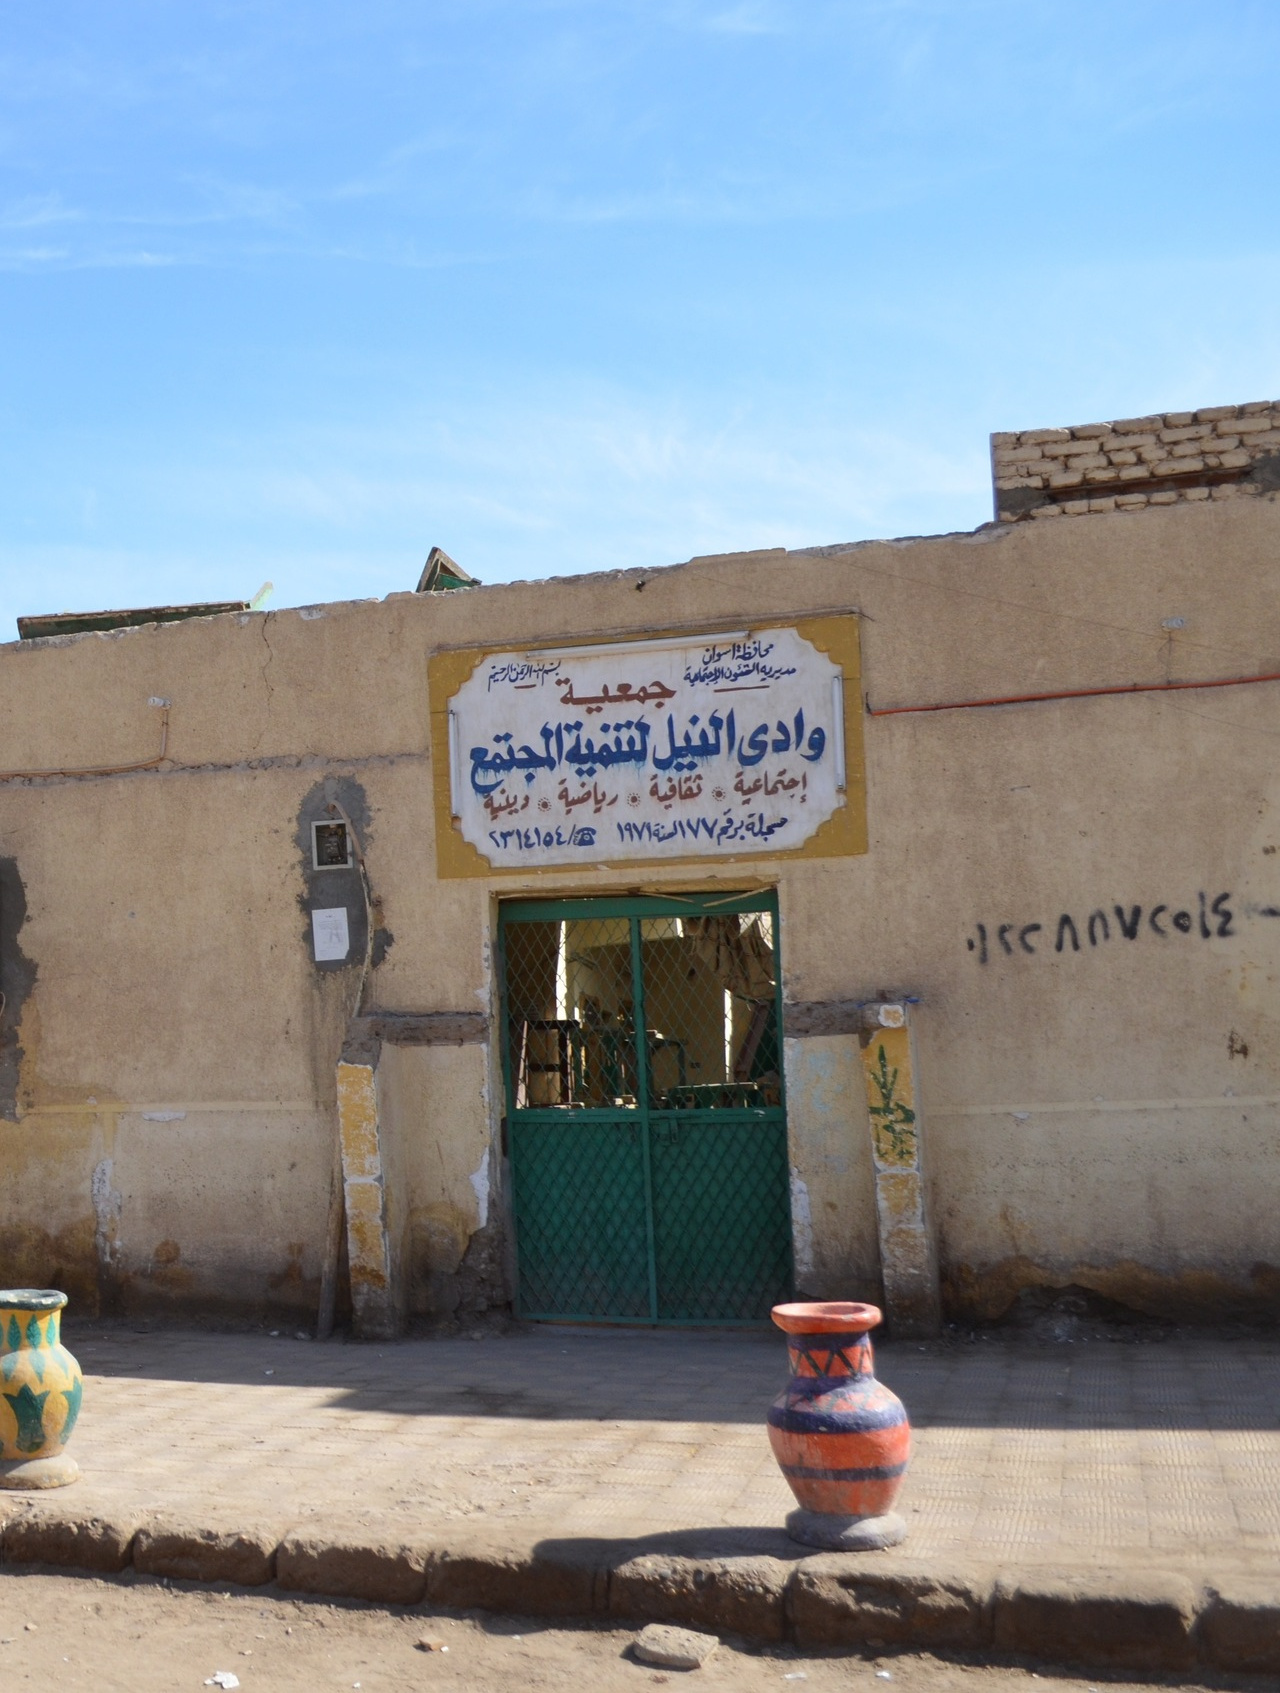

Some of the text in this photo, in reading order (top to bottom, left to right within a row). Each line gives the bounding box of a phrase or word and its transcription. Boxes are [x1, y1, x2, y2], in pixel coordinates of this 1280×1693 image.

[702, 640, 774, 665] محافظة اسوان
[488, 663, 513, 692] الرحيم
[509, 662, 533, 682] الرحمن
[542, 660, 562, 686] بسم
[556, 676, 677, 715] جمعية
[469, 721, 563, 795] المجتمع
[563, 713, 651, 777] لتنمية
[653, 710, 737, 772] النيل
[483, 768, 807, 821] إجتماعية ثقافية رياضية دينية
[680, 817, 718, 840] ١٧٧
[716, 808, 746, 846] برقم
[745, 812, 788, 842] مسجلة
